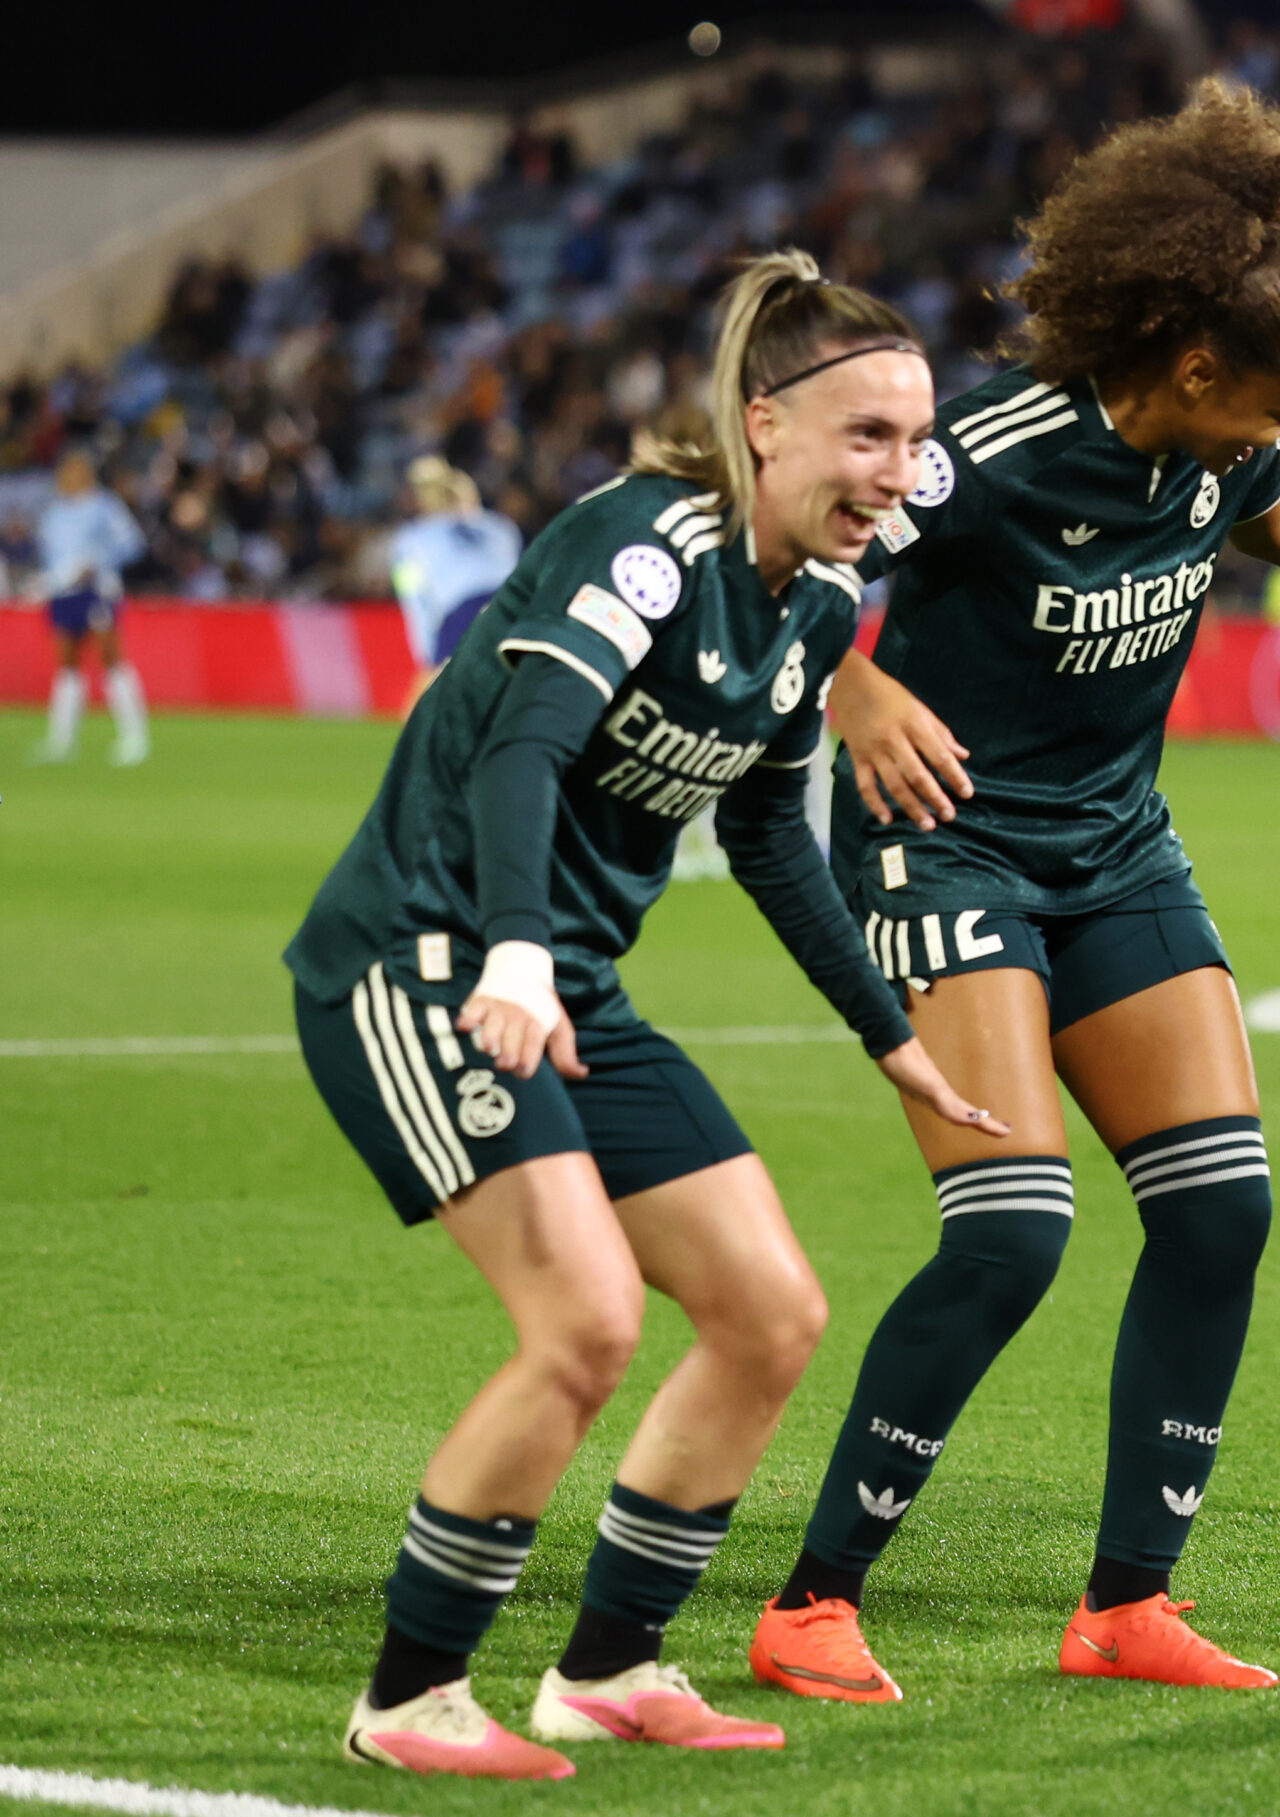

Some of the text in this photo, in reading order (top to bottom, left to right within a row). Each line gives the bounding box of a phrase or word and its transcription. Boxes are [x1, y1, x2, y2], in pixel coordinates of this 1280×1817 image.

[1032, 552, 1217, 634] Emirates
[1055, 608, 1193, 674] FLY BETTER
[595, 757, 666, 801] FLY
[1161, 1418, 1223, 1446] RMC
